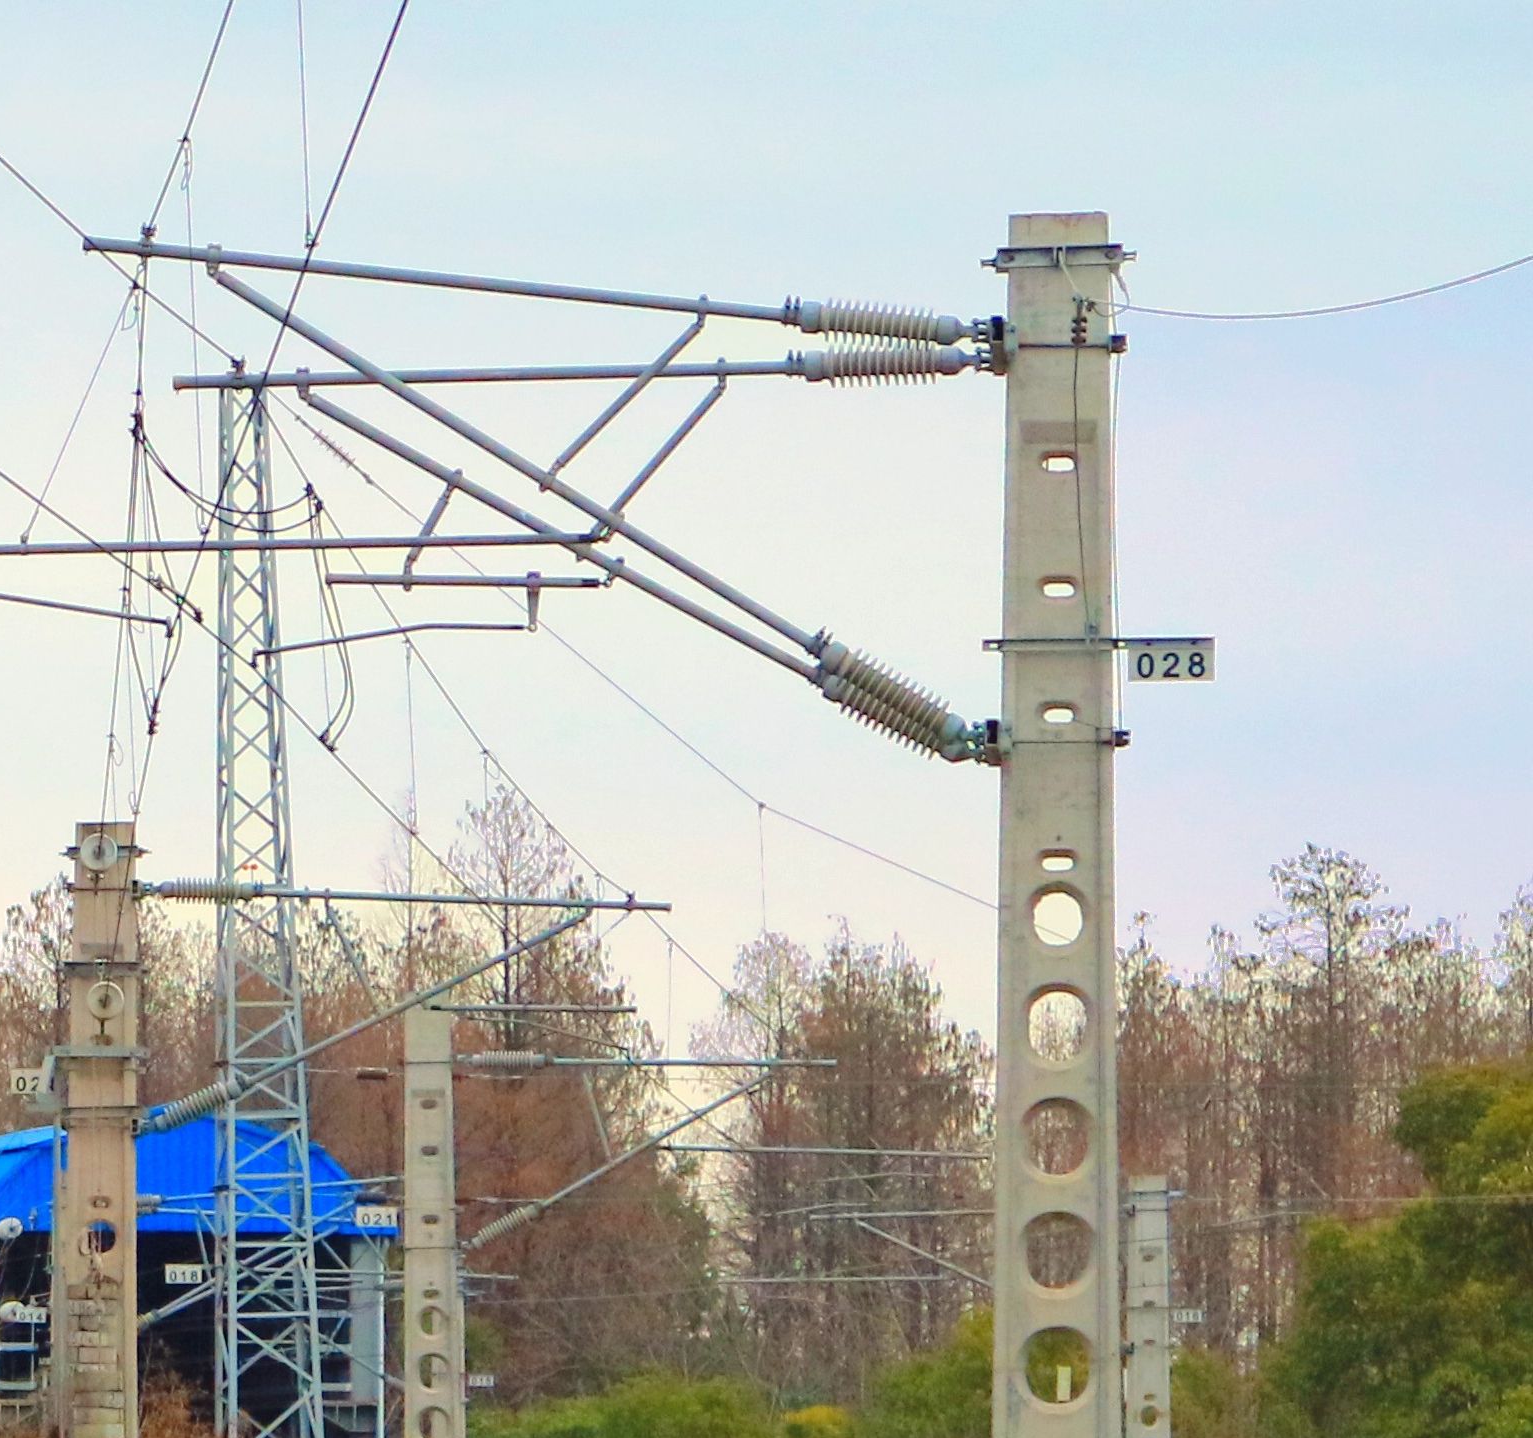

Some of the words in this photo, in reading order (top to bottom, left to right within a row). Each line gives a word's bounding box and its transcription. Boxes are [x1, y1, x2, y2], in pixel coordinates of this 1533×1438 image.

[1136, 652, 1206, 679] 028
[361, 1212, 393, 1226] 021
[169, 1269, 198, 1282] 018
